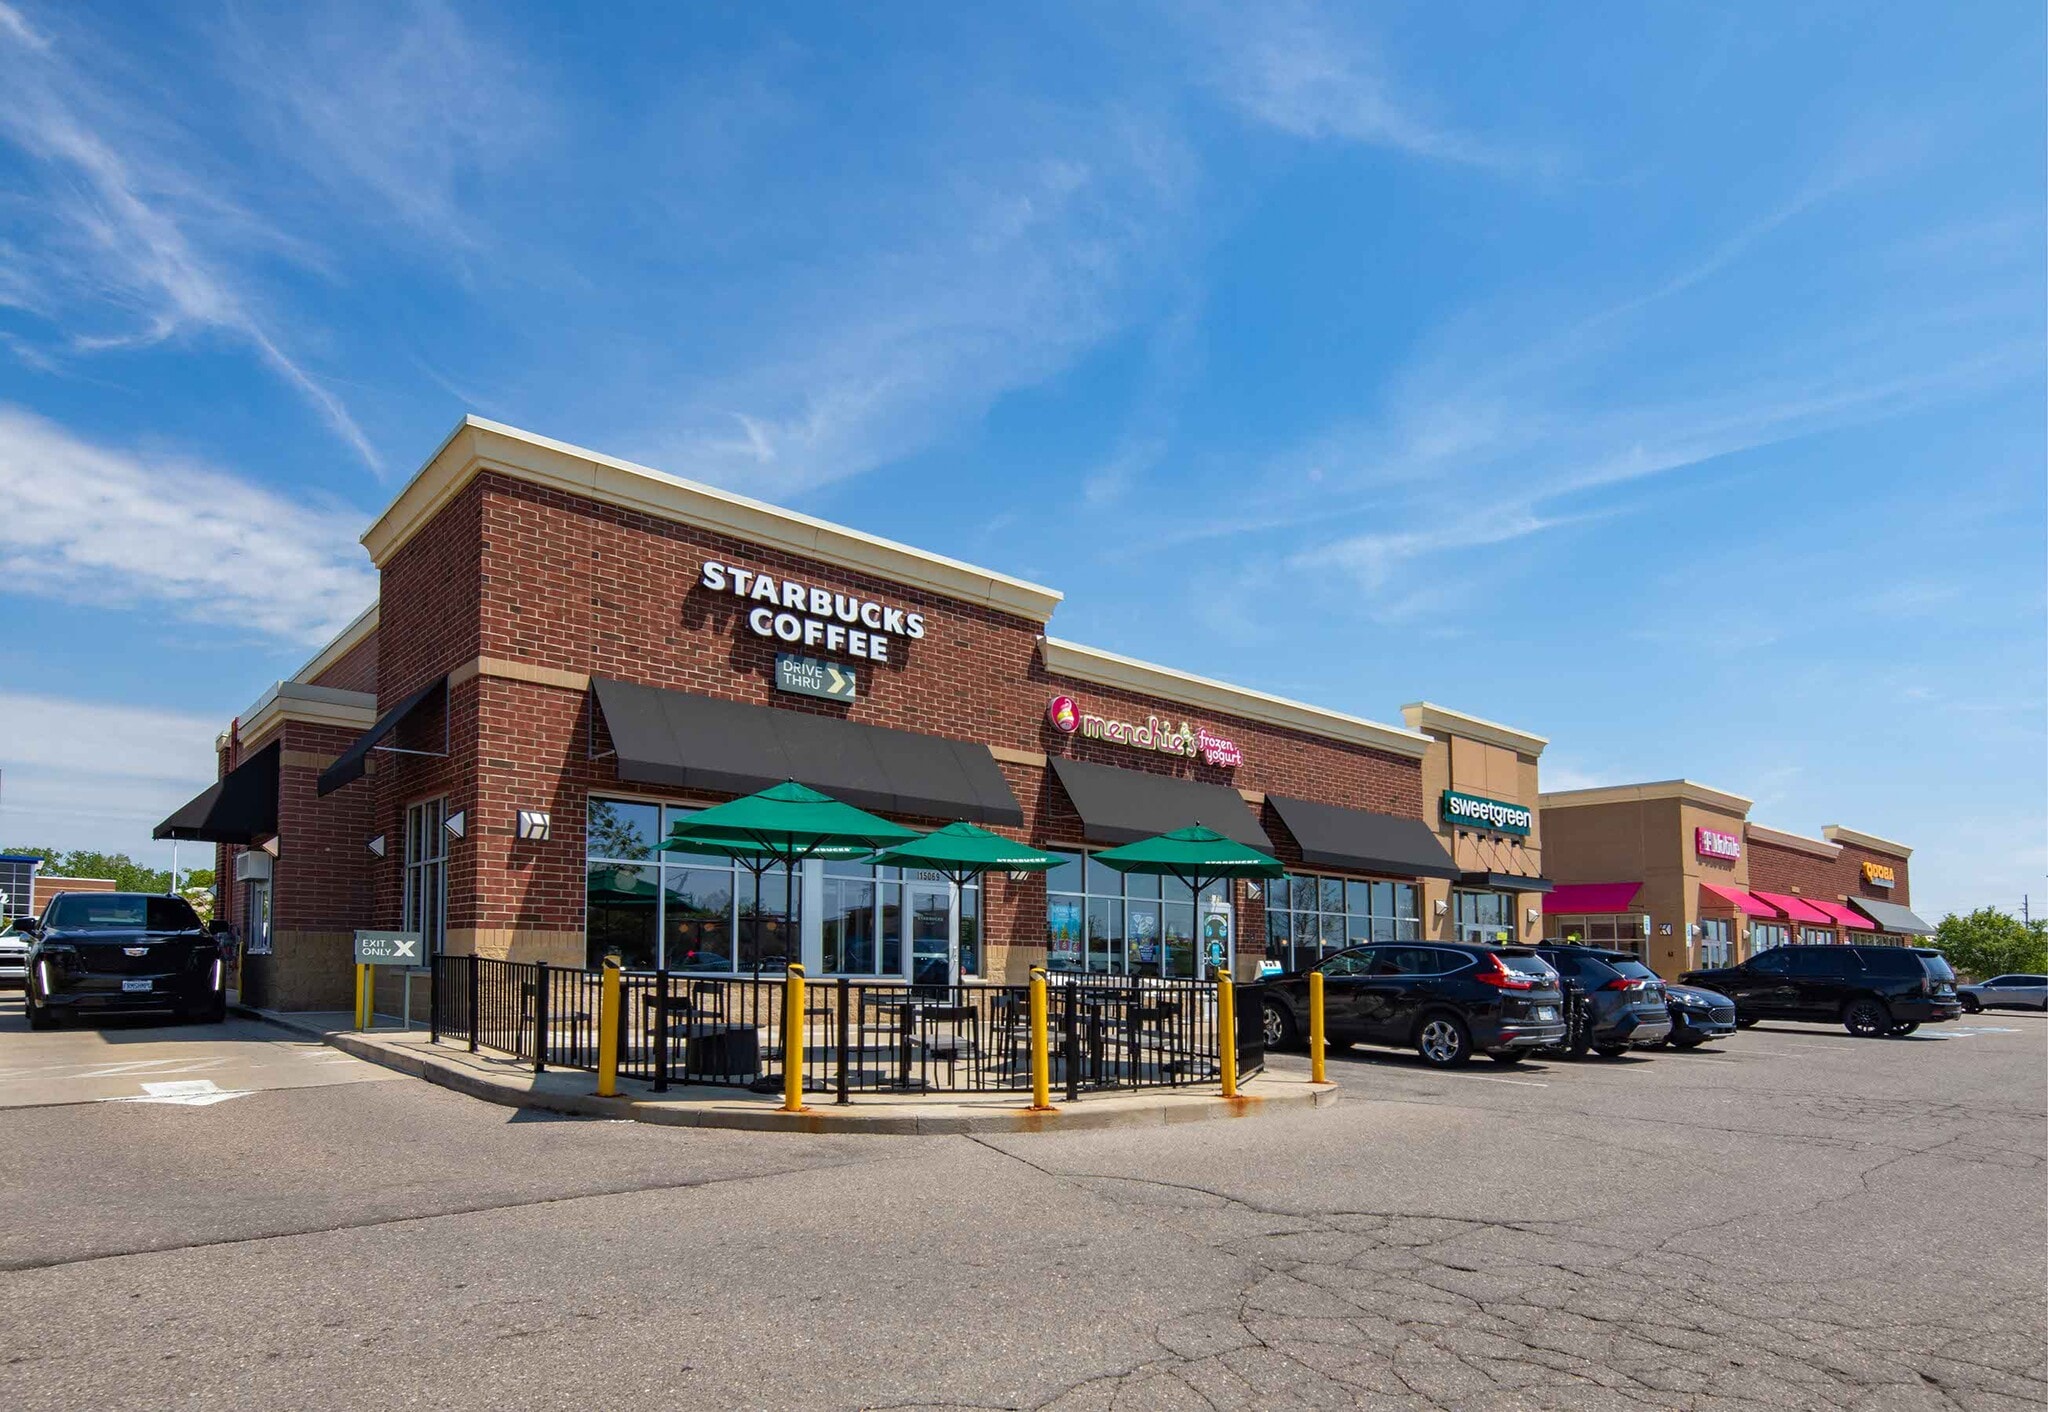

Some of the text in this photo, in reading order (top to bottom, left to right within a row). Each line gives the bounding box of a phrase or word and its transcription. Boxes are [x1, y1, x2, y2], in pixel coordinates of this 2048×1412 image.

[702, 561, 925, 639] STARBUCKS
[749, 607, 888, 662] COFFEE
[782, 659, 823, 679] DRIVE
[784, 673, 821, 690] THRU
[1199, 729, 1234, 751] frozen
[1206, 747, 1242, 766] yogurt
[1450, 797, 1532, 828] sweetgreen
[1863, 861, 1895, 884] QDOBA
[361, 947, 392, 956] ONLY
[362, 939, 387, 948] EXIT
